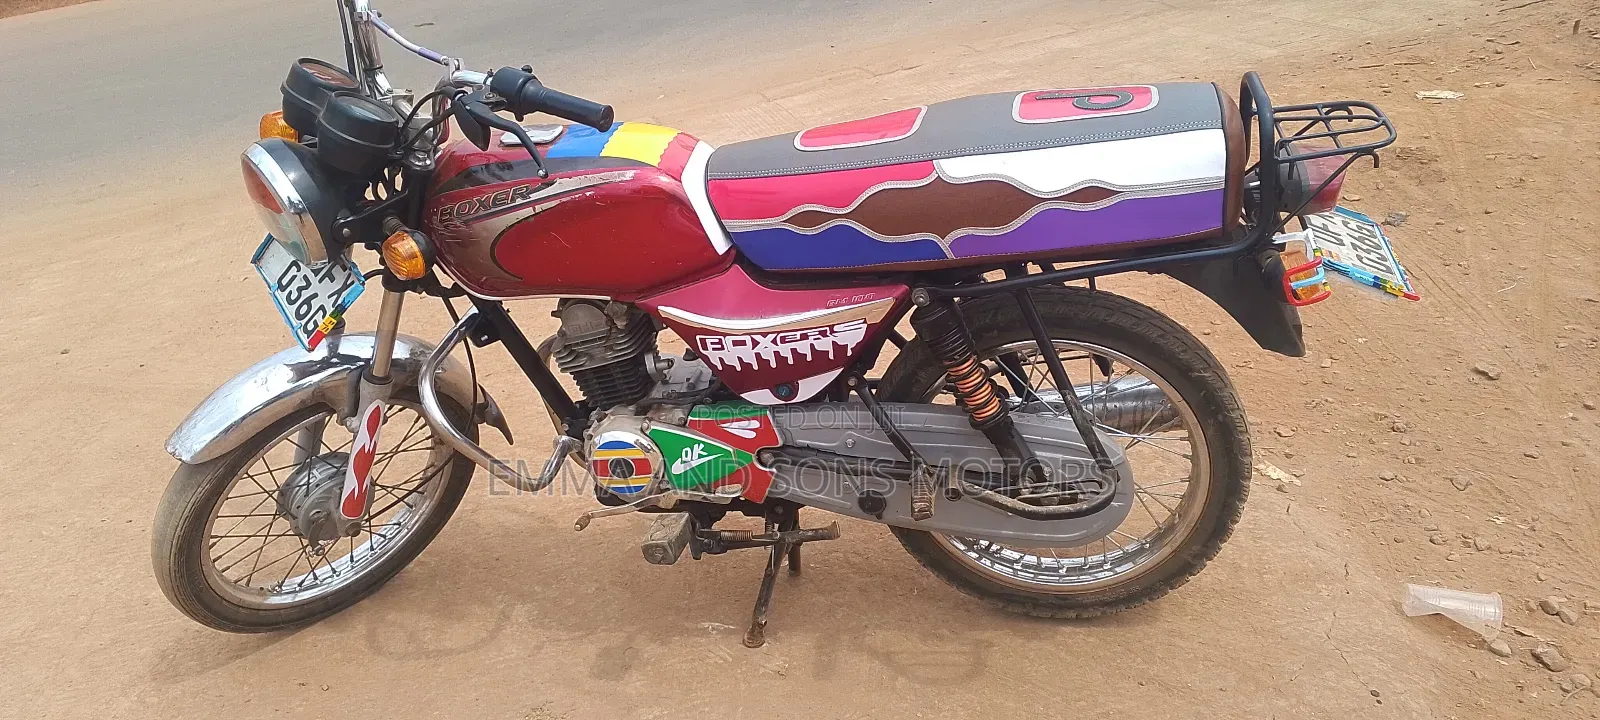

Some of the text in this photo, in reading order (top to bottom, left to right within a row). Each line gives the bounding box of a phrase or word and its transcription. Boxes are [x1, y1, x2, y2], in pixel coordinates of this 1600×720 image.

[438, 183, 533, 222] BOXER
[277, 260, 328, 339] 036G
[696, 319, 867, 360] BOXERS
[682, 442, 708, 462] OK
